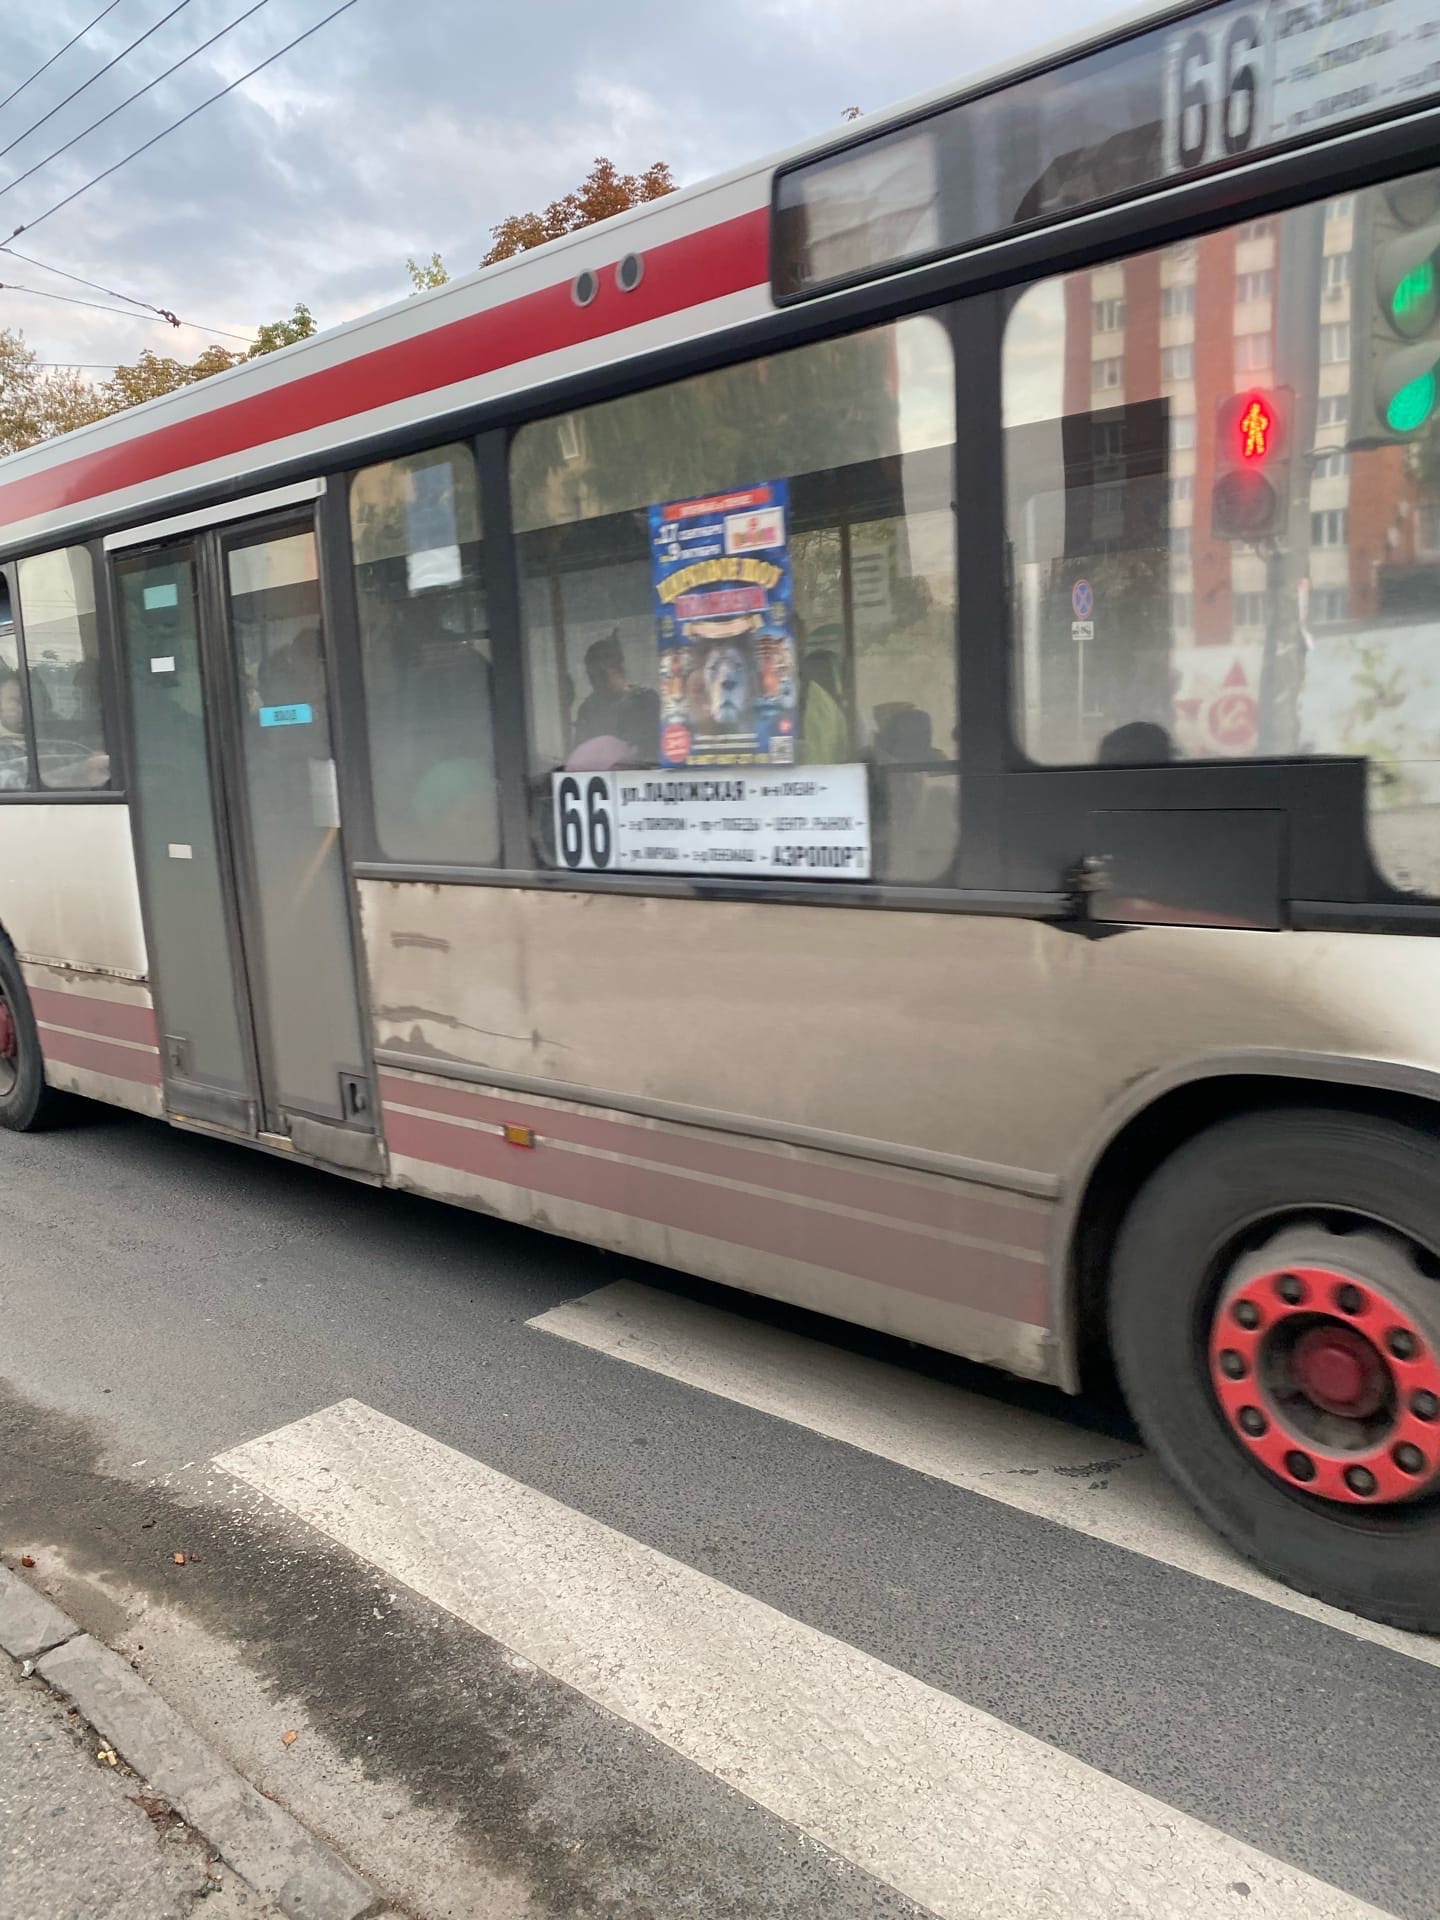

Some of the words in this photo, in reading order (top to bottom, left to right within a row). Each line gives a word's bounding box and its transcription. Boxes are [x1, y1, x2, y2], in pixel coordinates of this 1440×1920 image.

[1179, 15, 1257, 168] 66
[560, 776, 611, 868] 66
[771, 846, 866, 868] АЭРОПОРТ
